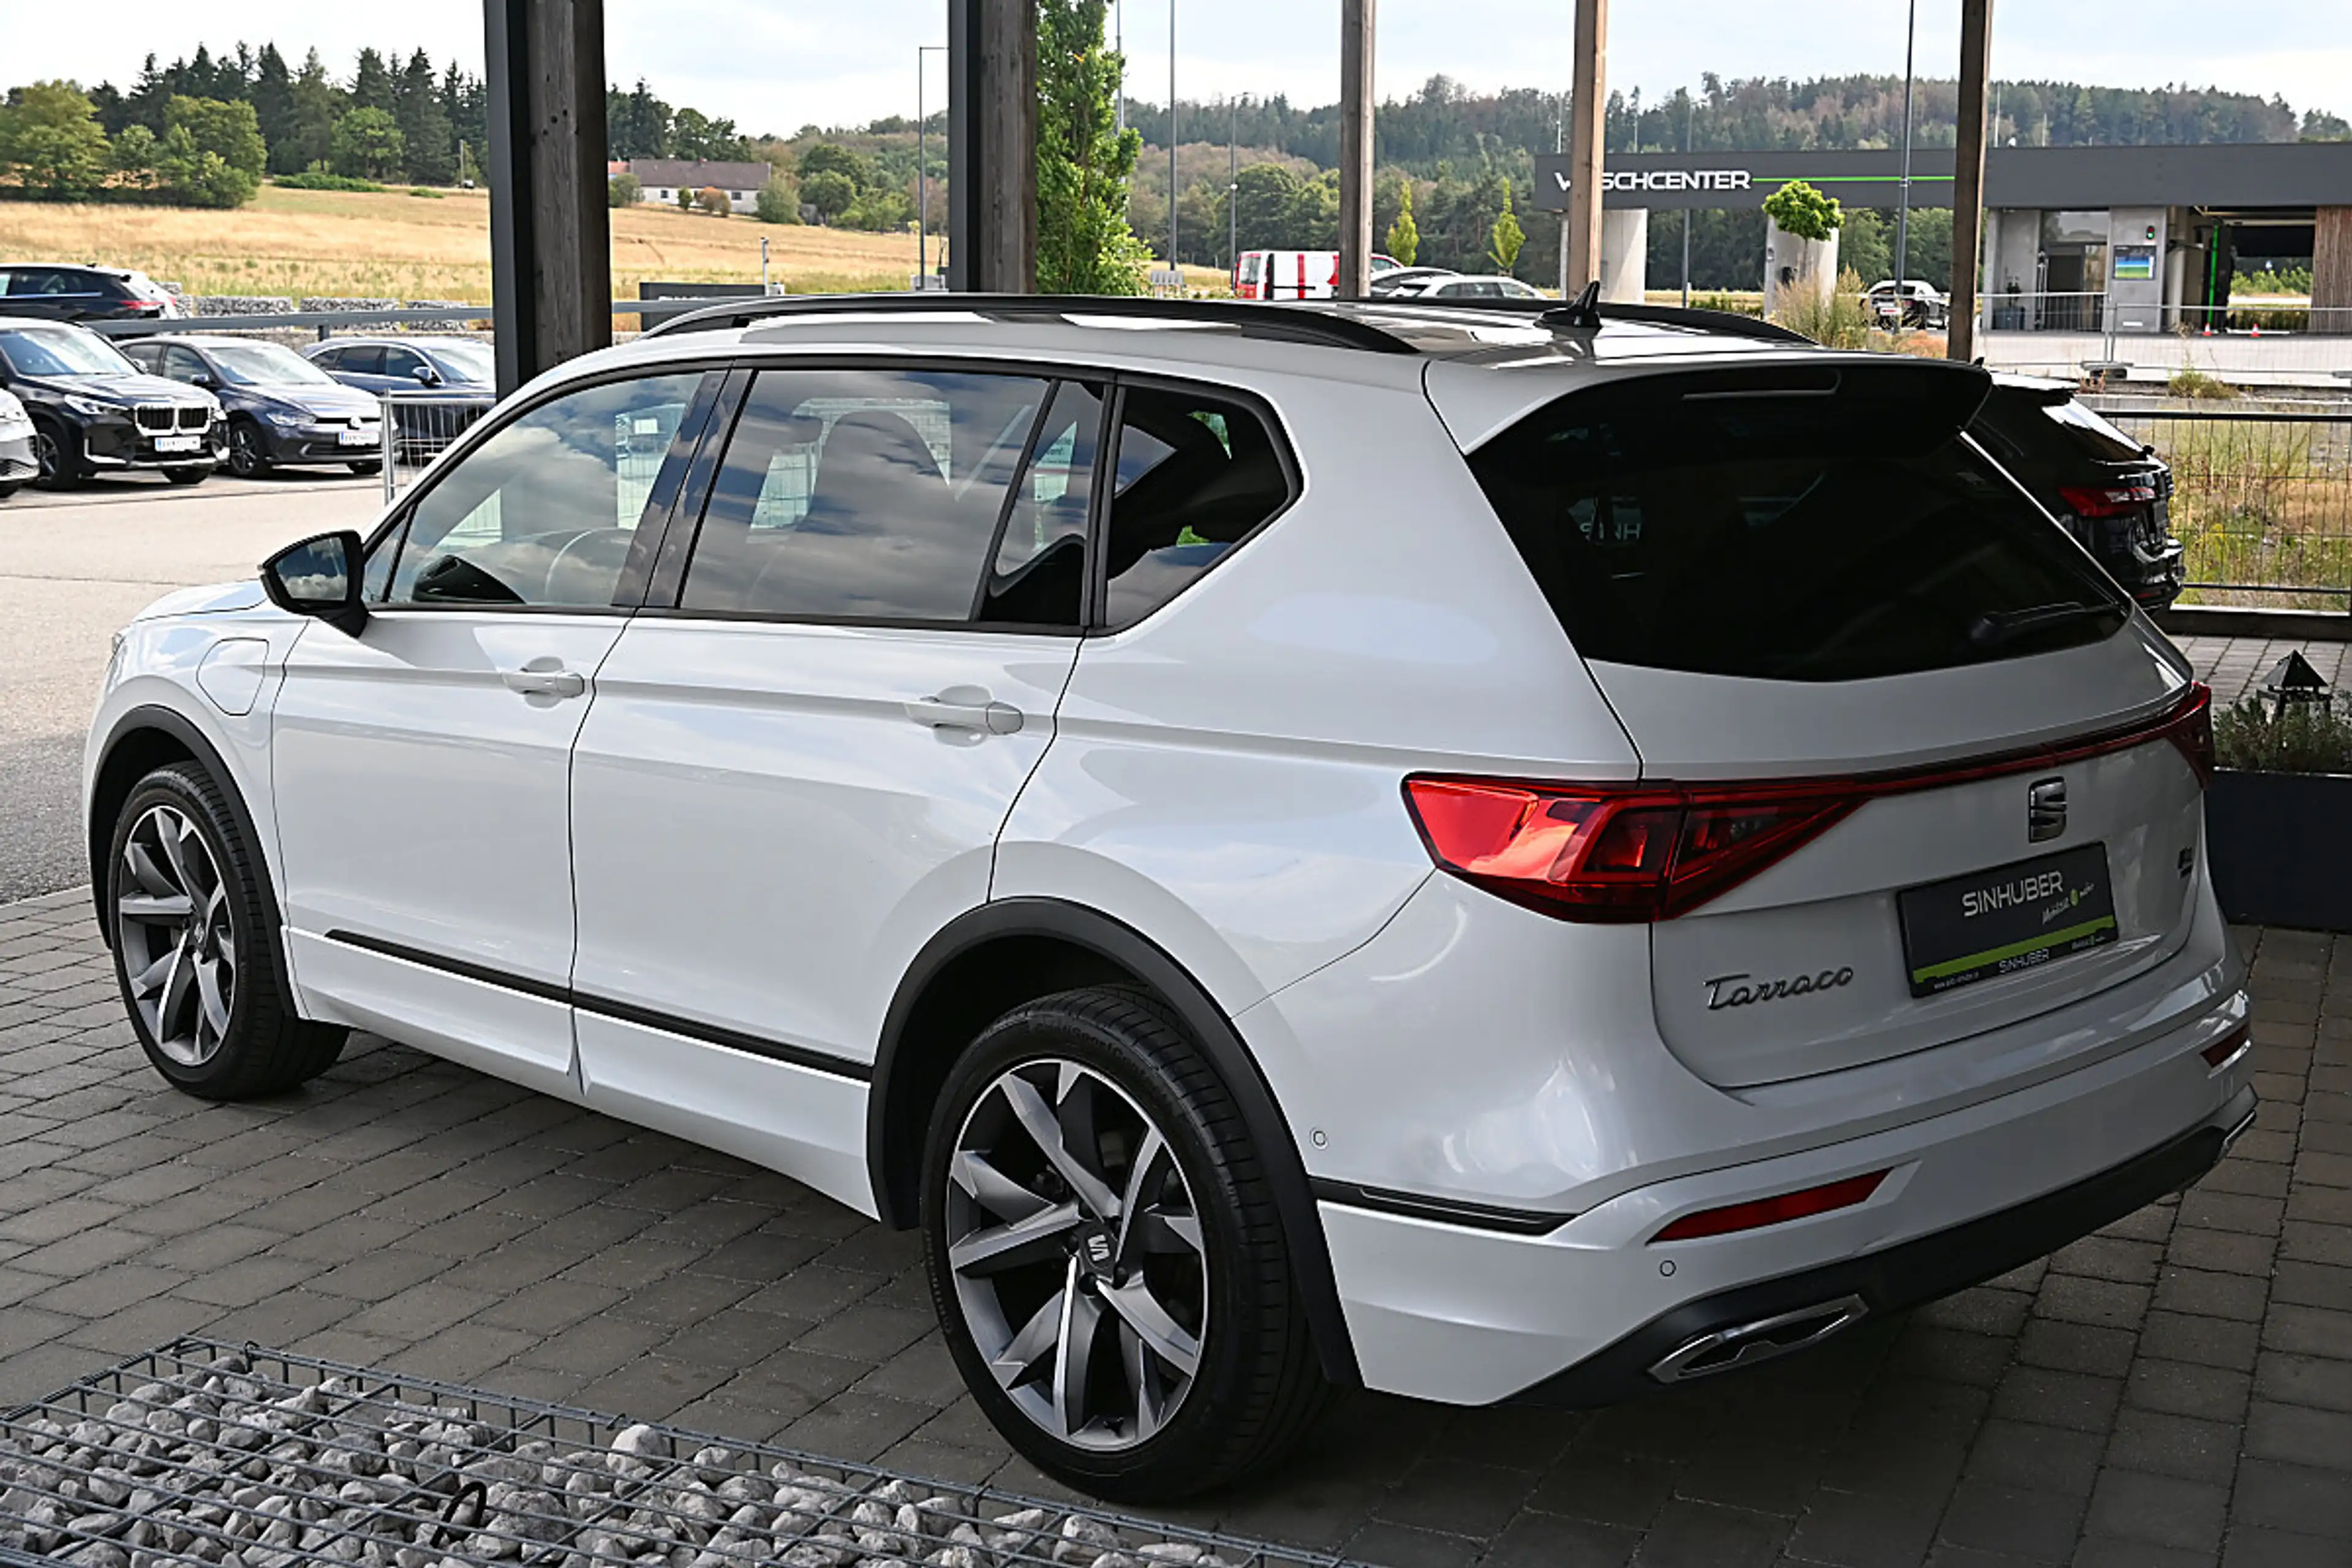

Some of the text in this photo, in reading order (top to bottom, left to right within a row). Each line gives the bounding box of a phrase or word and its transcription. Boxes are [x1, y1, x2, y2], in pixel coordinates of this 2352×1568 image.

[1554, 171, 1751, 190] WSCHCENTER
[1962, 870, 2064, 917] SINHUBER
[1999, 948, 2050, 973] SINHUBER
[1703, 966, 1853, 1011] Tarraco
